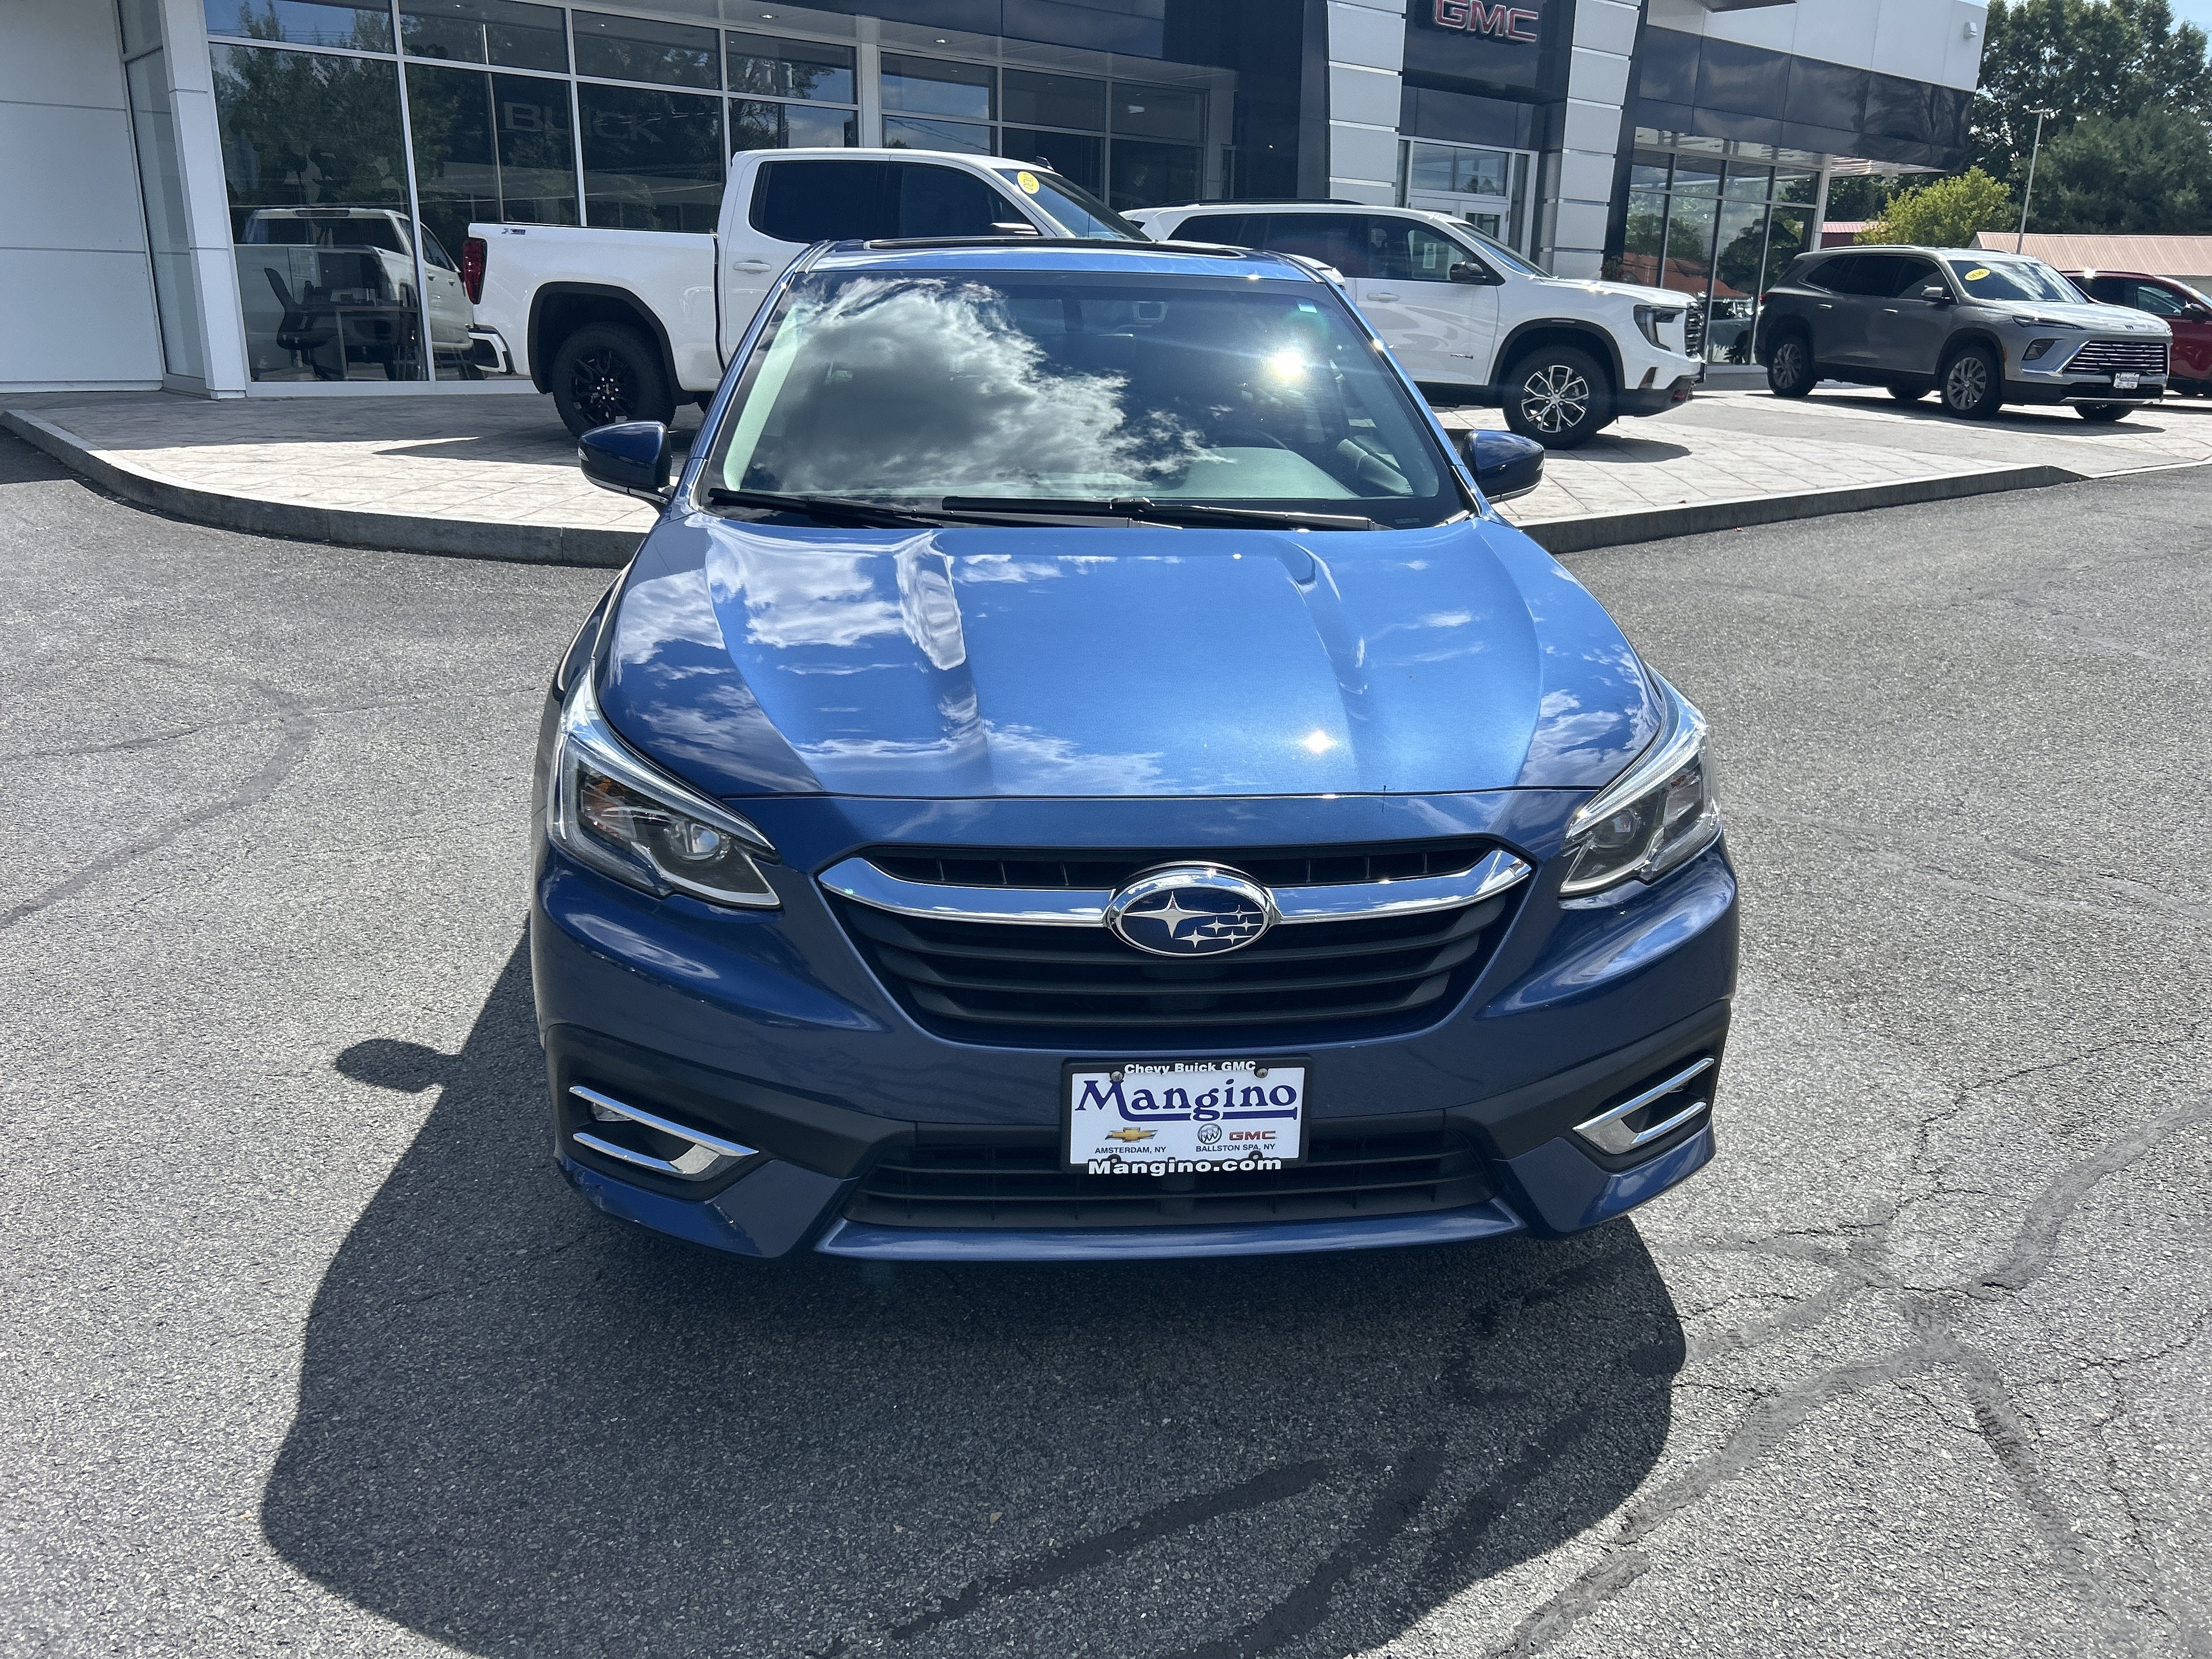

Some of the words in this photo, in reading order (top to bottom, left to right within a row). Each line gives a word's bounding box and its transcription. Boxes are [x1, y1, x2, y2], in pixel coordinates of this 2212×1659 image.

[1435, 0, 1539, 43] GMC
[1124, 1064, 1170, 1074] Chevy
[1175, 1062, 1216, 1073] Buick
[1221, 1060, 1256, 1071] GMC
[1075, 1079, 1297, 1122] Mangino
[1229, 1131, 1277, 1141] GMC
[1088, 1159, 1282, 1177] Mangino.com
